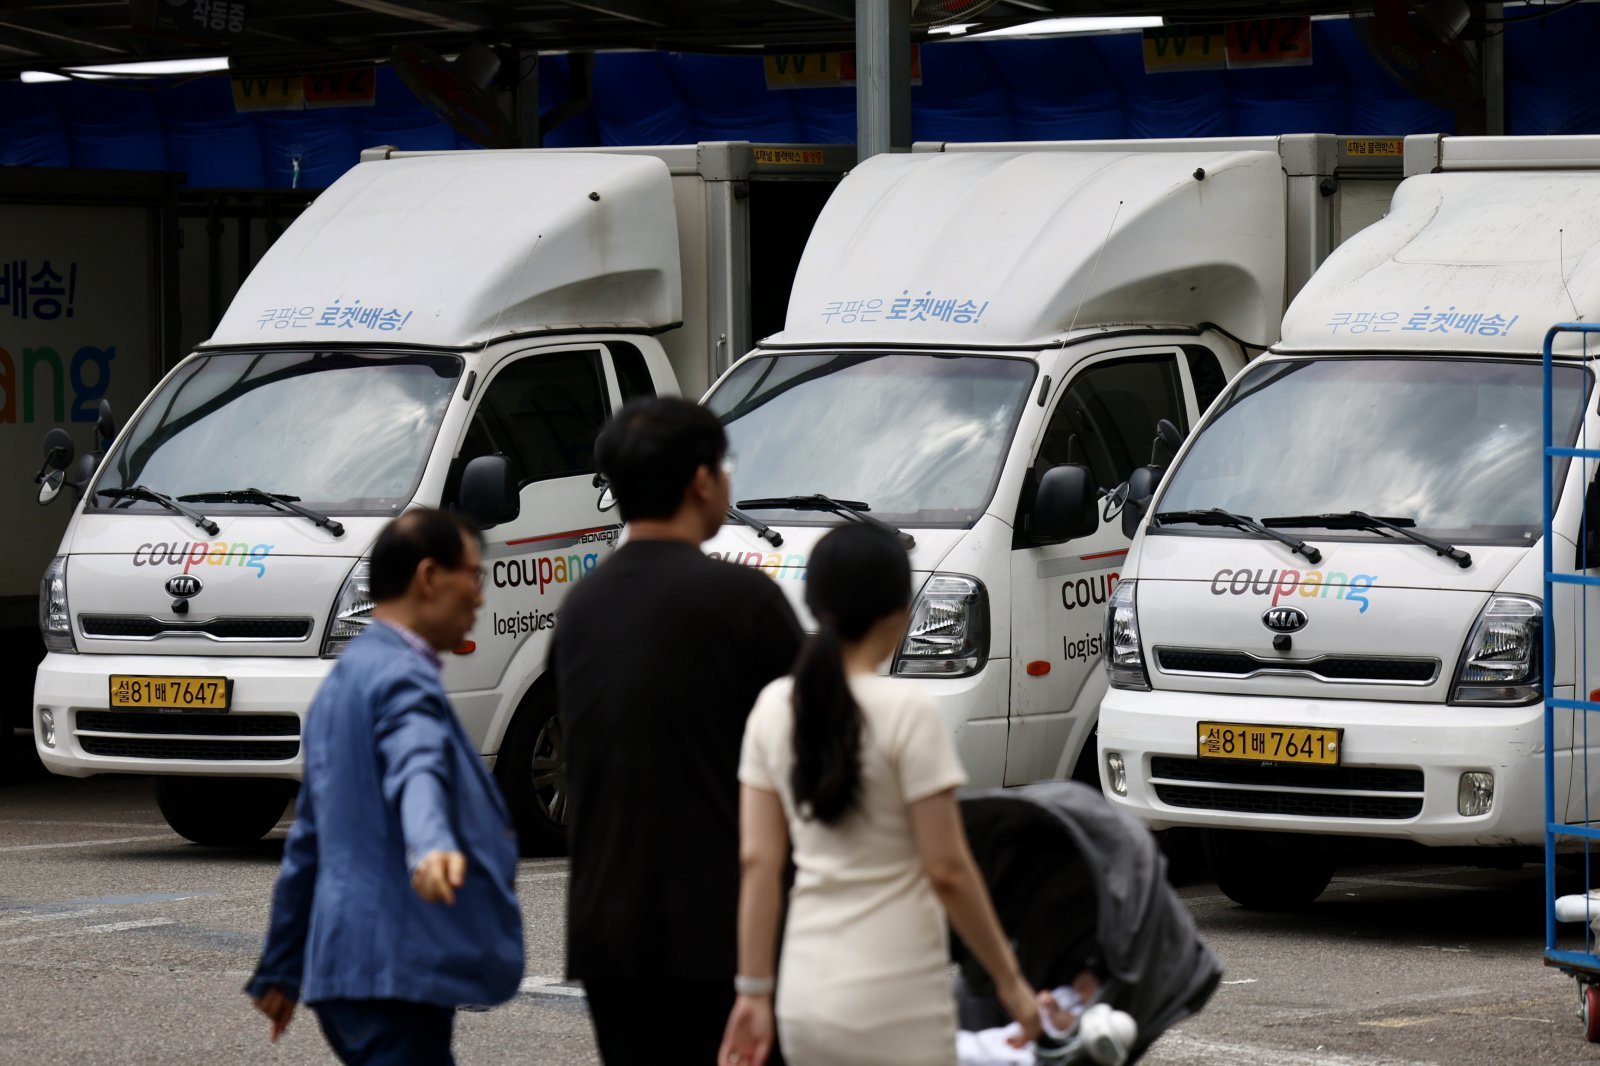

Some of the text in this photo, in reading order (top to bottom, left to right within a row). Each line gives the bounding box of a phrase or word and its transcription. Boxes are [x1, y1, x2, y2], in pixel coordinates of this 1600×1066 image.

[256, 300, 413, 331] 쿠팡은 로켓배송!
[820, 290, 989, 325] 쿠팡은 로켓배송!
[1326, 305, 1520, 337] 쿠팡은 로켓배송!
[132, 541, 275, 579] coupang
[169, 579, 195, 593] KIA
[1210, 568, 1378, 614] coupang
[493, 608, 555, 639] logistics
[1268, 611, 1299, 627] KIA
[118, 680, 130, 703] 서울
[170, 682, 218, 704] 7647
[1207, 728, 1221, 753] 서울
[1270, 732, 1325, 759] 7641
